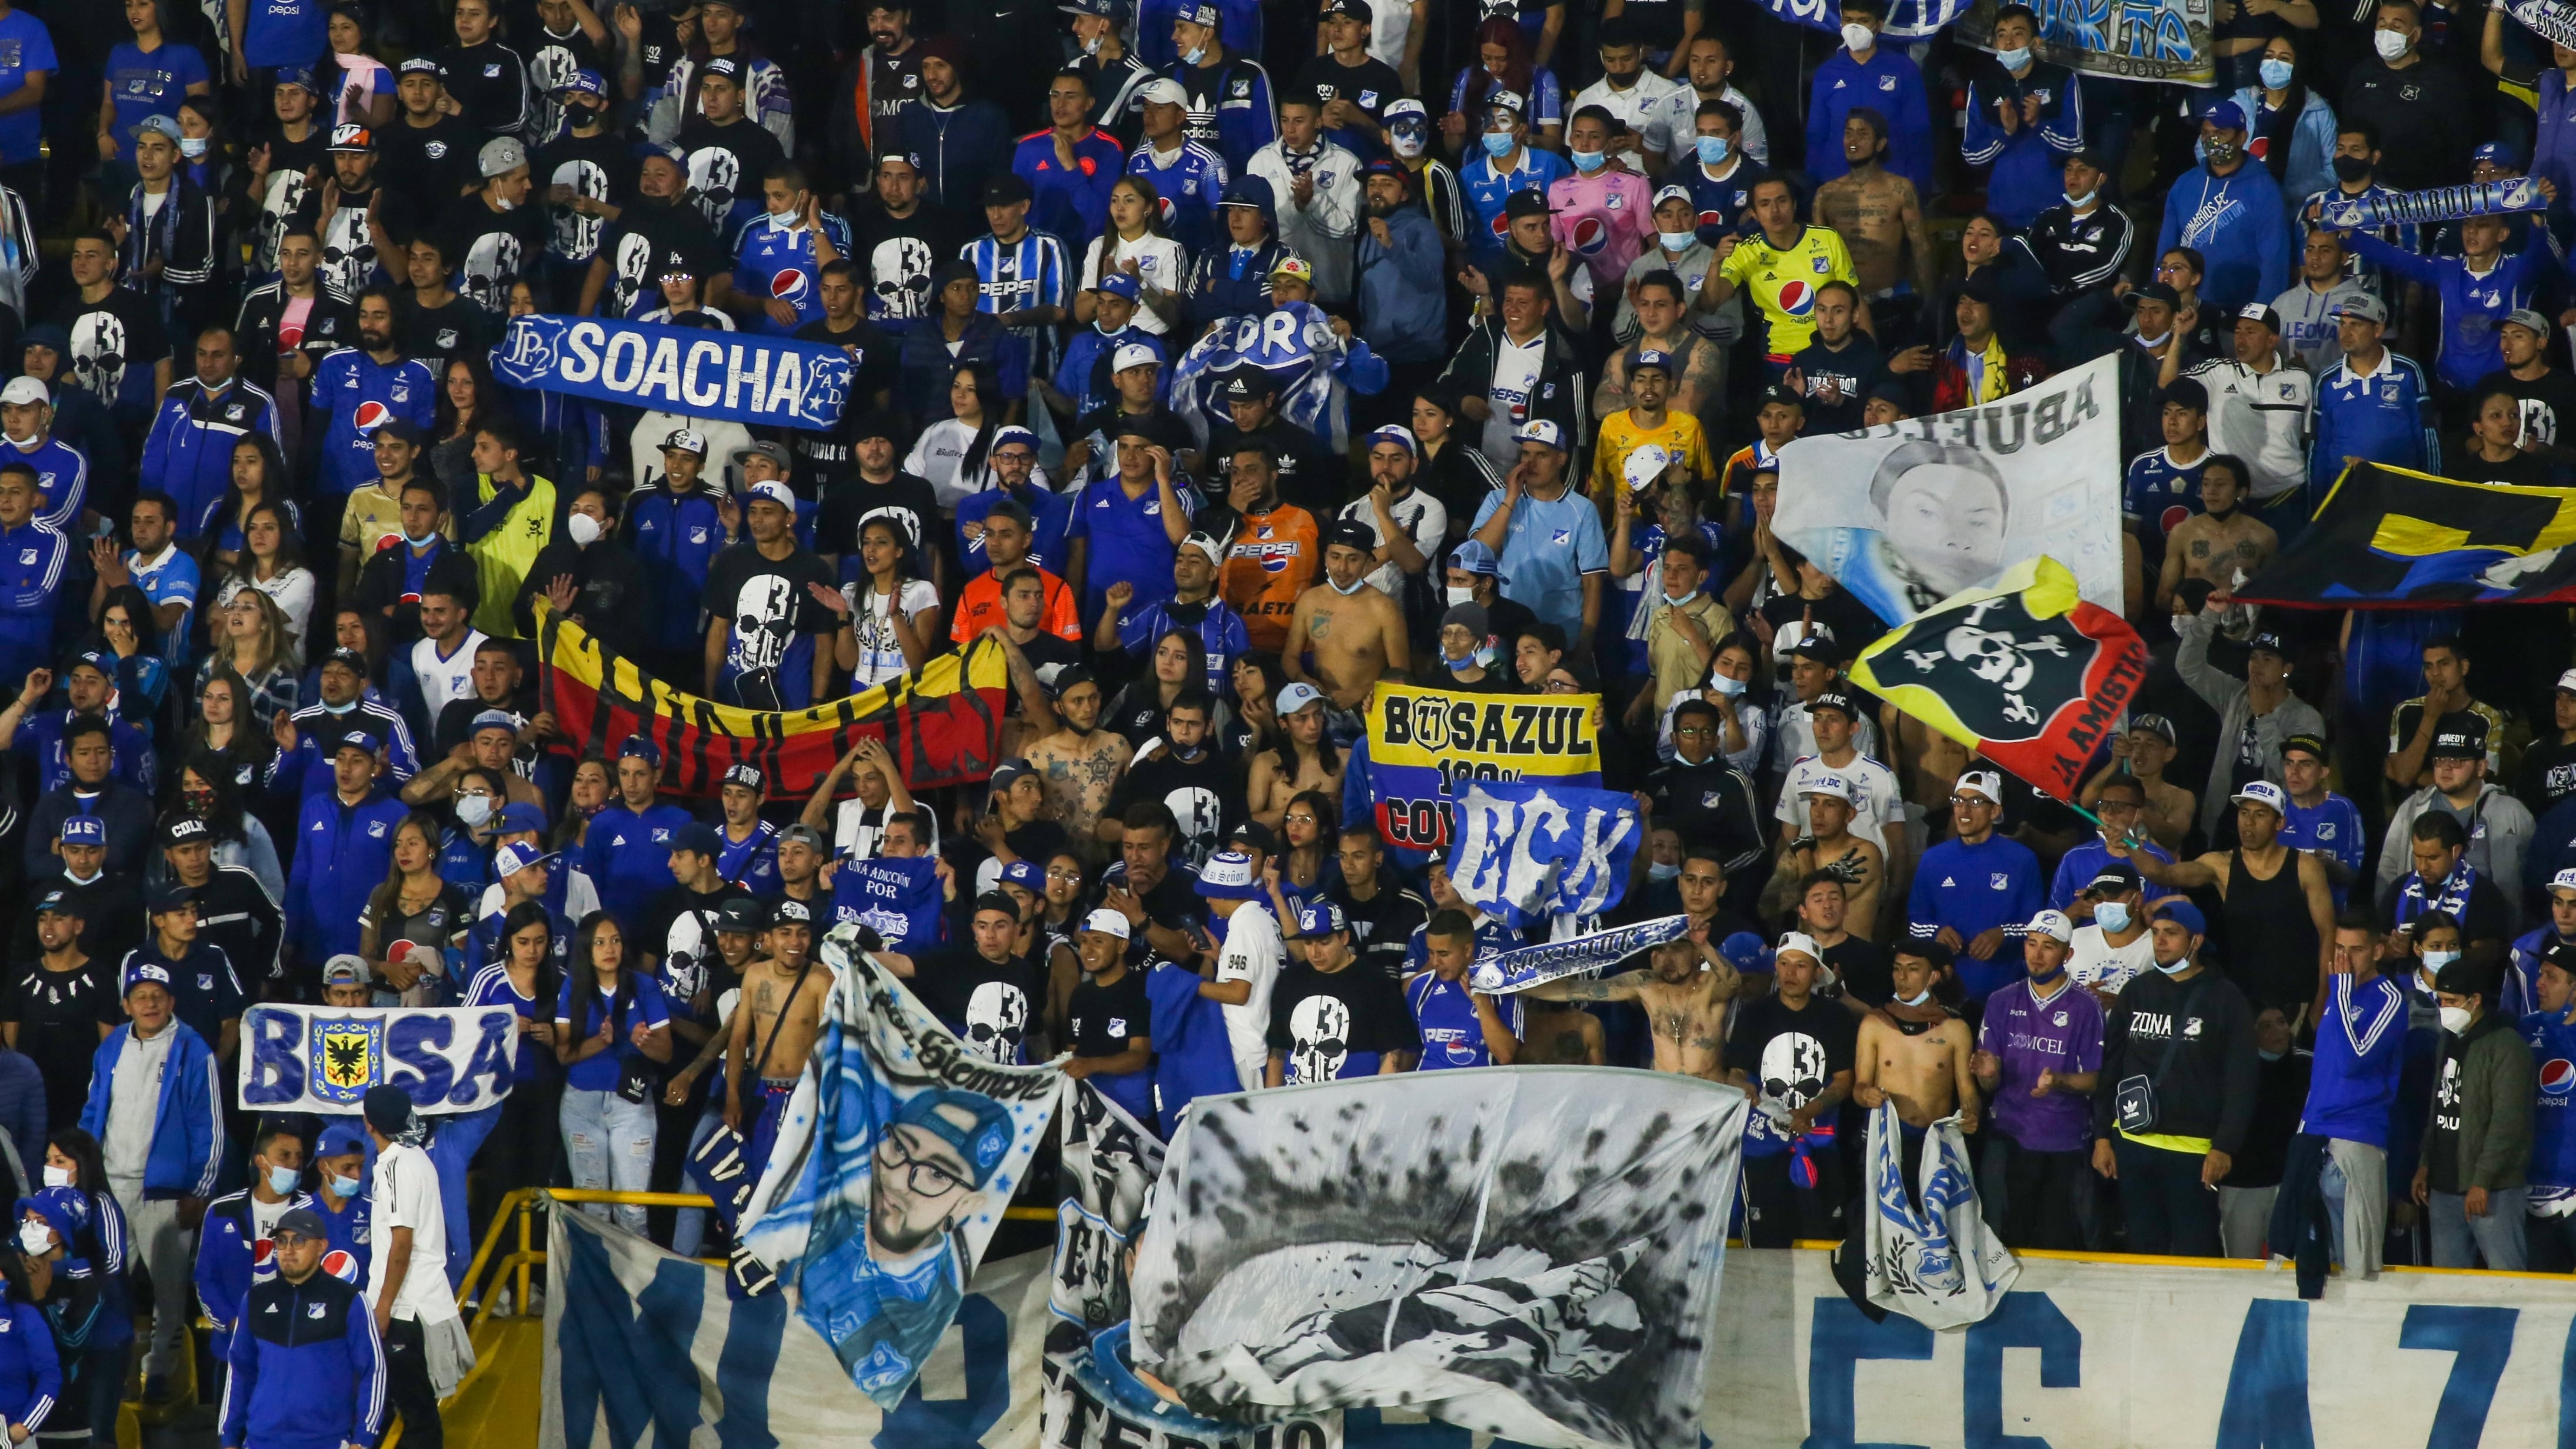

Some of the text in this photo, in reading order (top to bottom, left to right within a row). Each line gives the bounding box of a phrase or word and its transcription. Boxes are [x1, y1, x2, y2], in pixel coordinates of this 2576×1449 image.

[269, 5, 299, 15] pepsi
[332, 123, 370, 147] KTM
[670, 251, 683, 264] LA
[560, 321, 801, 417] SOACHA
[1491, 387, 1527, 404] PEPSI
[1228, 542, 1300, 557] PEPSI
[848, 861, 910, 888] UNA ADICCIÓN
[866, 881, 897, 899] POR
[1143, 947, 1156, 966] CITY
[2130, 1011, 2171, 1035] ZONA
[2538, 1096, 2568, 1107] pepsi
